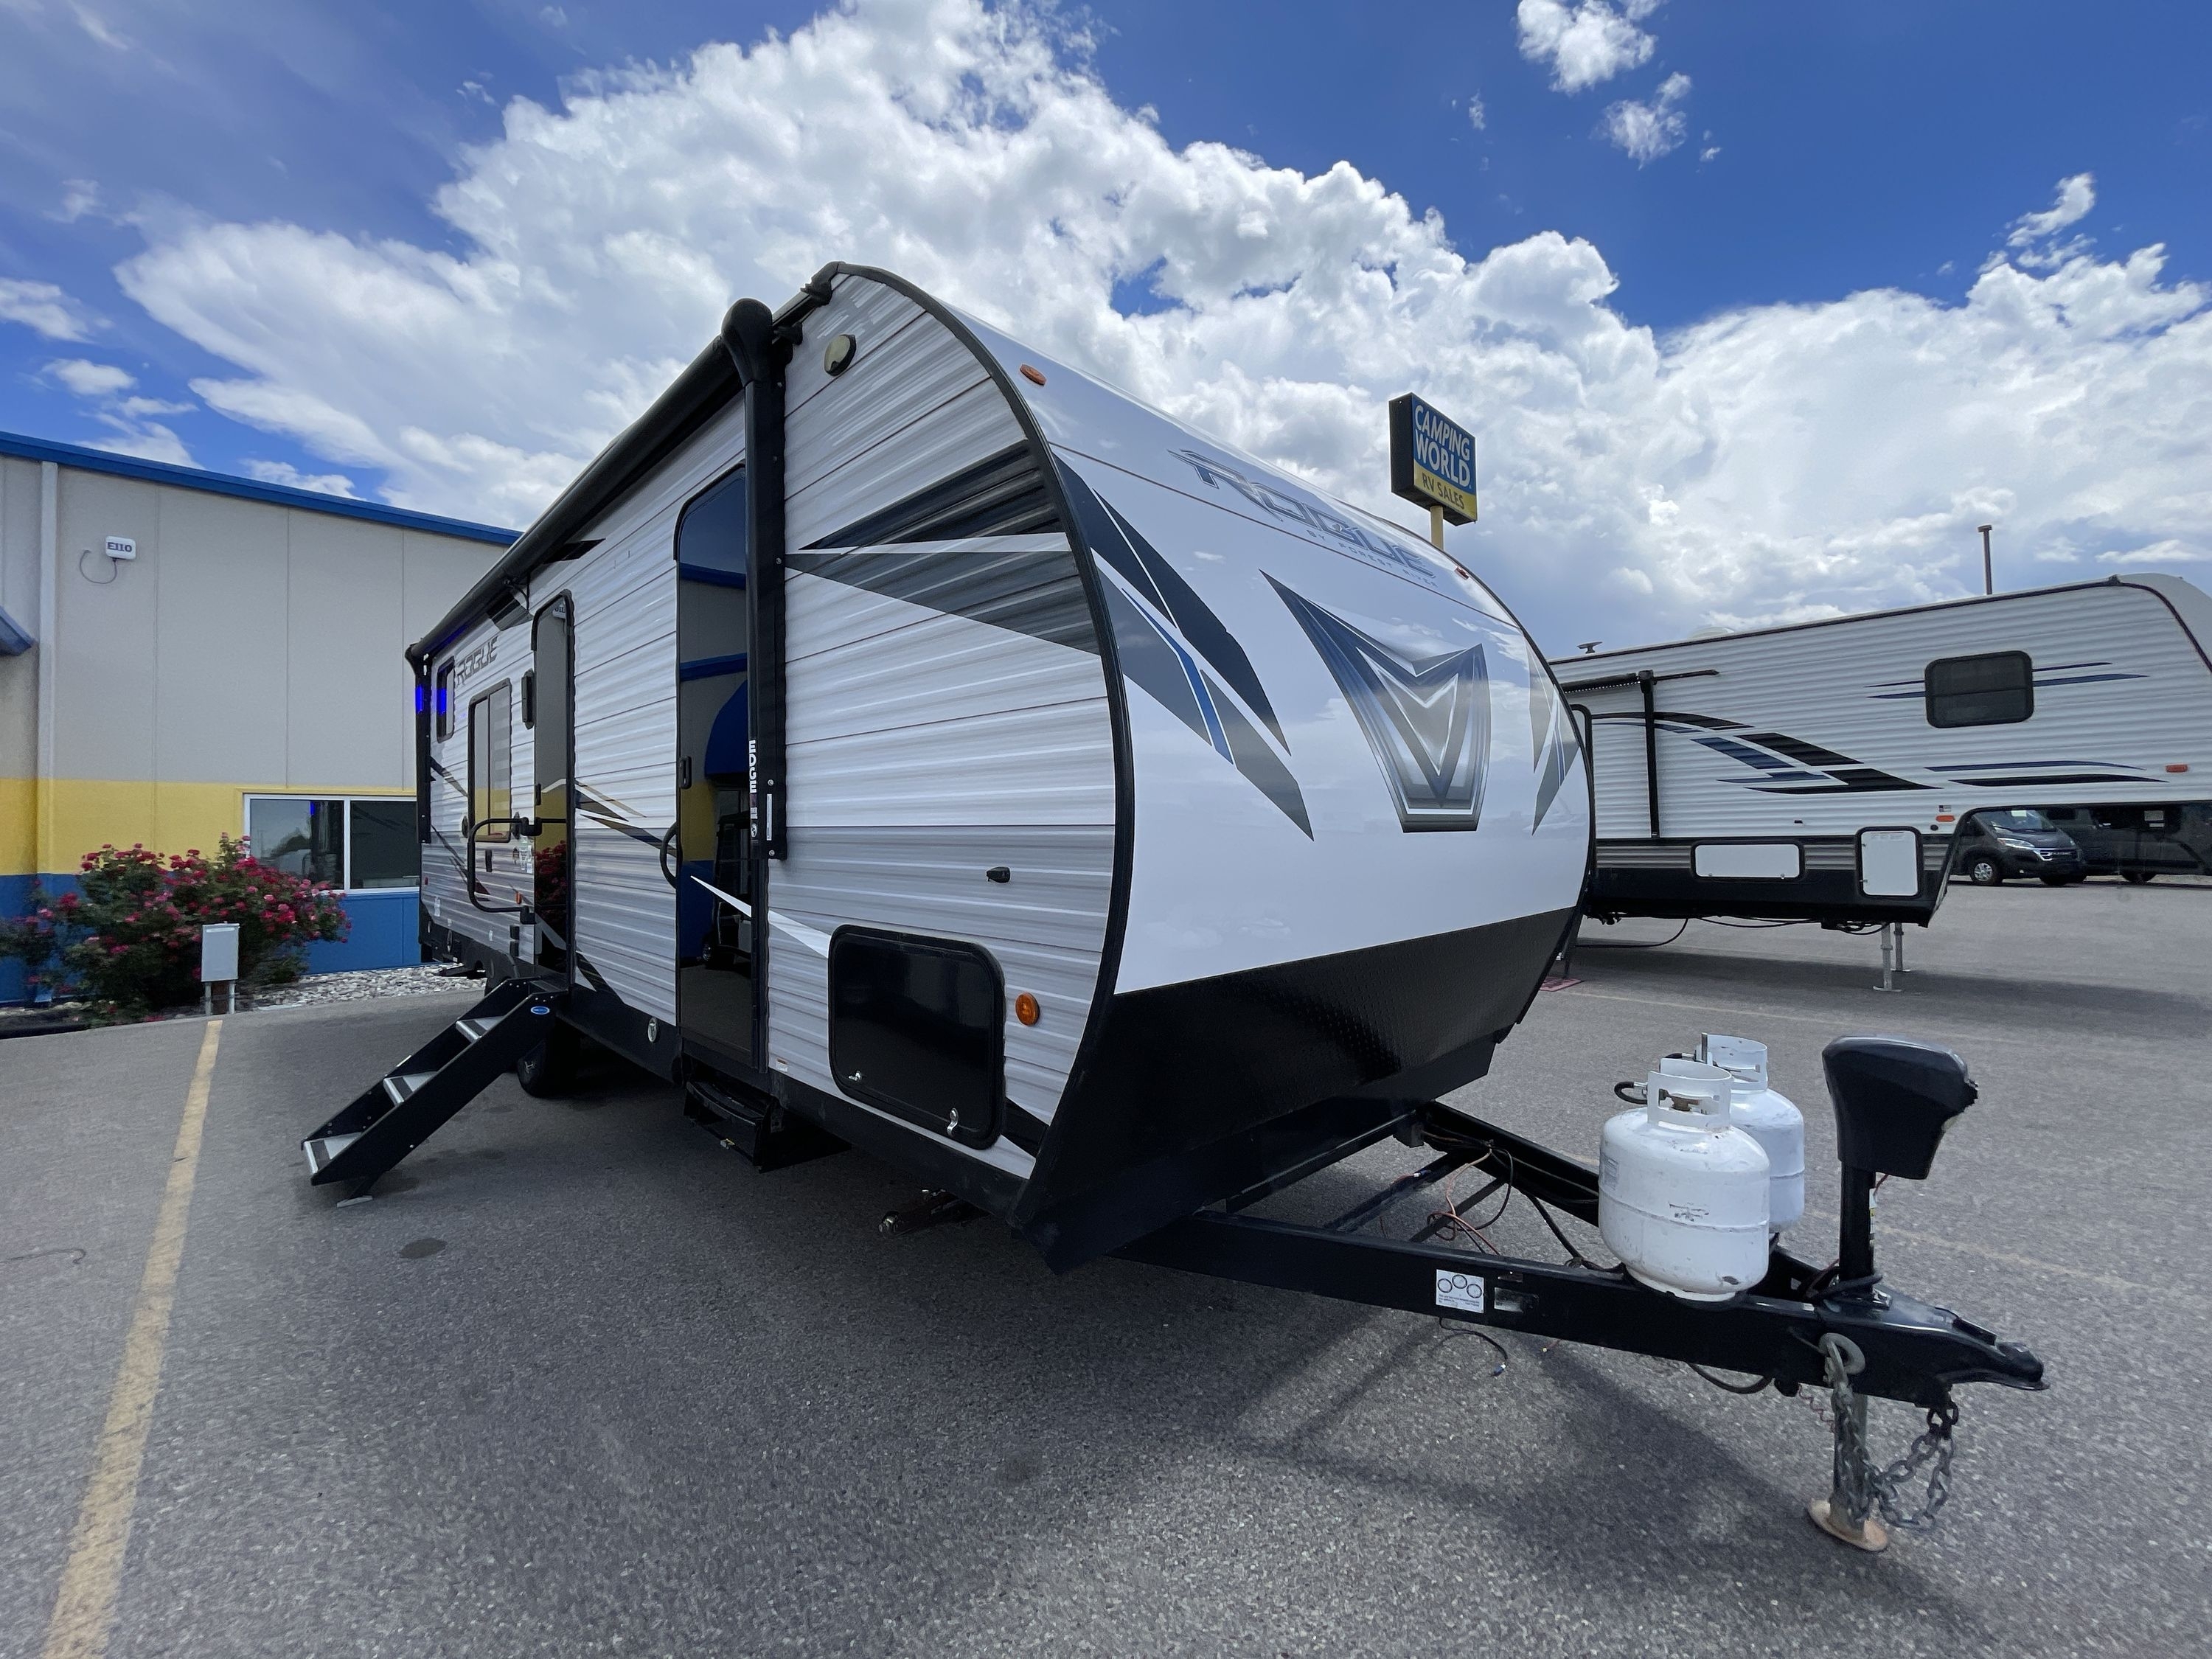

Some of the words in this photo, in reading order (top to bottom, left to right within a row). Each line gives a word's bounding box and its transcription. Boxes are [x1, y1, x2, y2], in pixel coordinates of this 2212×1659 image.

[1415, 405, 1470, 461] CAMPING
[1415, 428, 1470, 487] WORLD
[1166, 448, 1436, 580] ROGUE
[1422, 473, 1435, 493] RV
[1437, 481, 1465, 509] SALES
[456, 636, 498, 686] ROGUE
[748, 740, 757, 793] EDGE
